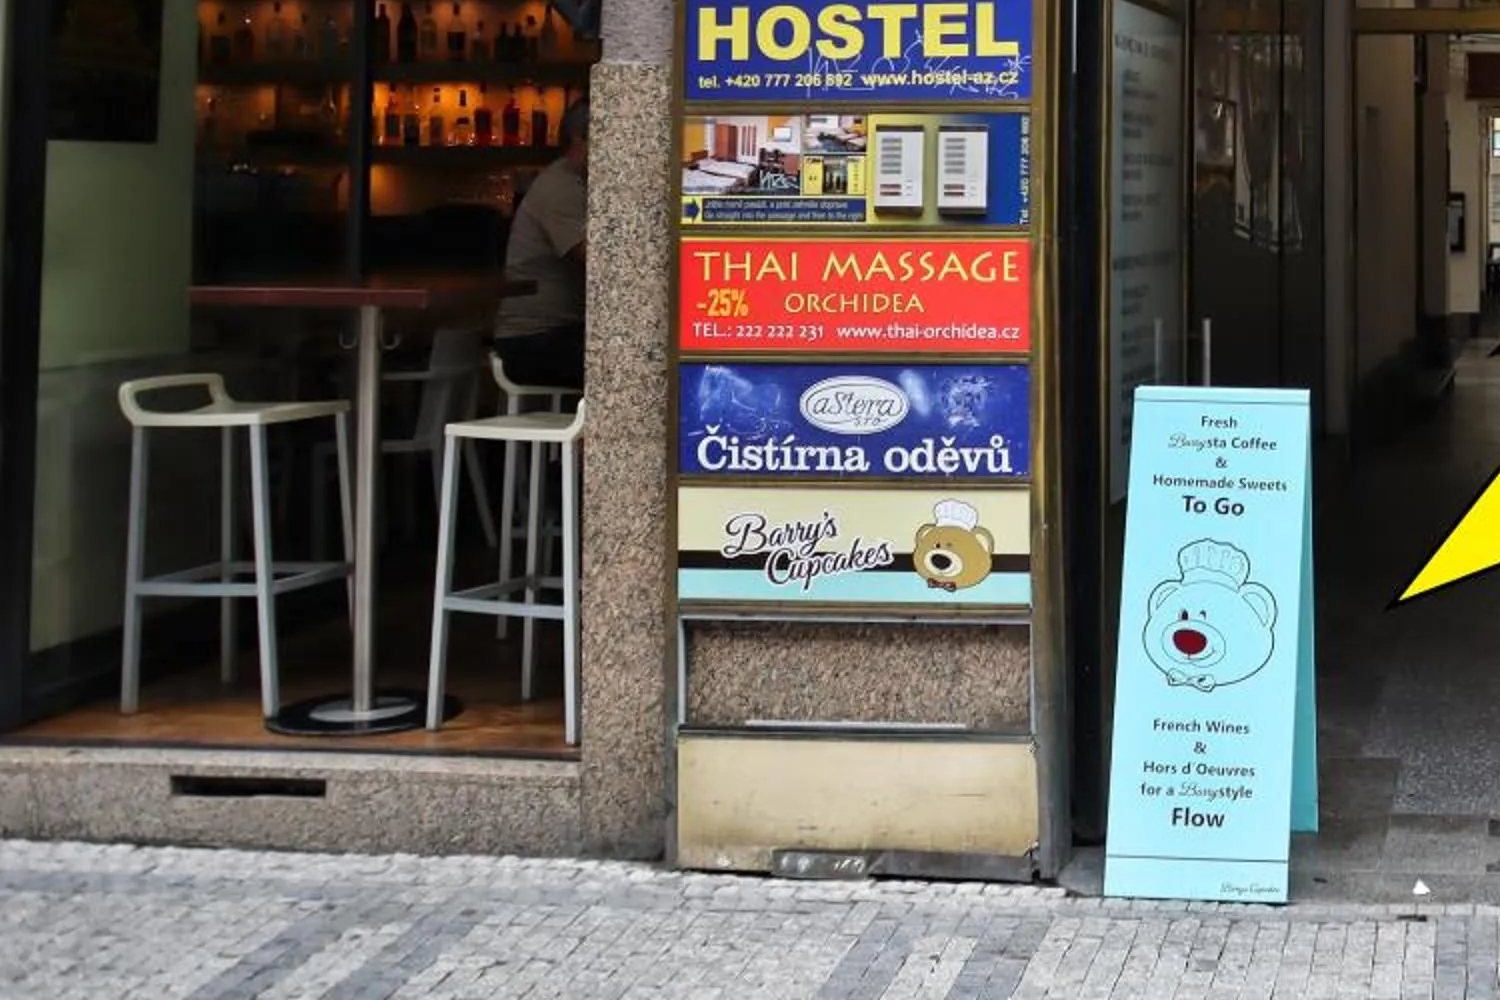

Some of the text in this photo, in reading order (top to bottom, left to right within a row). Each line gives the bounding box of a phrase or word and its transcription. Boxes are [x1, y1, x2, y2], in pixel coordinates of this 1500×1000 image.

[697, 2, 1020, 62] HOSTEL
[698, 73, 721, 89] tel.
[724, 73, 761, 88] +420
[764, 73, 791, 87] 777
[795, 73, 822, 87] 206
[861, 69, 1019, 88] www.hostel-az.cz
[693, 250, 1020, 282] THAI MASSAGE
[696, 287, 925, 318] -25% ORCHIDEA
[736, 323, 762, 338] 222
[767, 323, 794, 338] 222
[799, 324, 824, 341] 231
[836, 322, 1020, 341] www.thai-orchidea.cz
[1200, 416, 1238, 429] Fresh
[697, 425, 1014, 473] Čistírna oděvů
[1231, 437, 1278, 451] Coffee
[1214, 456, 1229, 469] &
[1152, 474, 1288, 492] Homemade Sweets
[1181, 495, 1246, 517] To Go
[721, 512, 838, 559] Barry's
[766, 537, 895, 591] Cupcakes
[1152, 718, 1250, 735] French Wines
[1193, 741, 1207, 755] &
[1143, 761, 1177, 775] Hors
[1139, 782, 1161, 797] for
[1165, 786, 1175, 797] a
[1171, 806, 1225, 828] Flow
